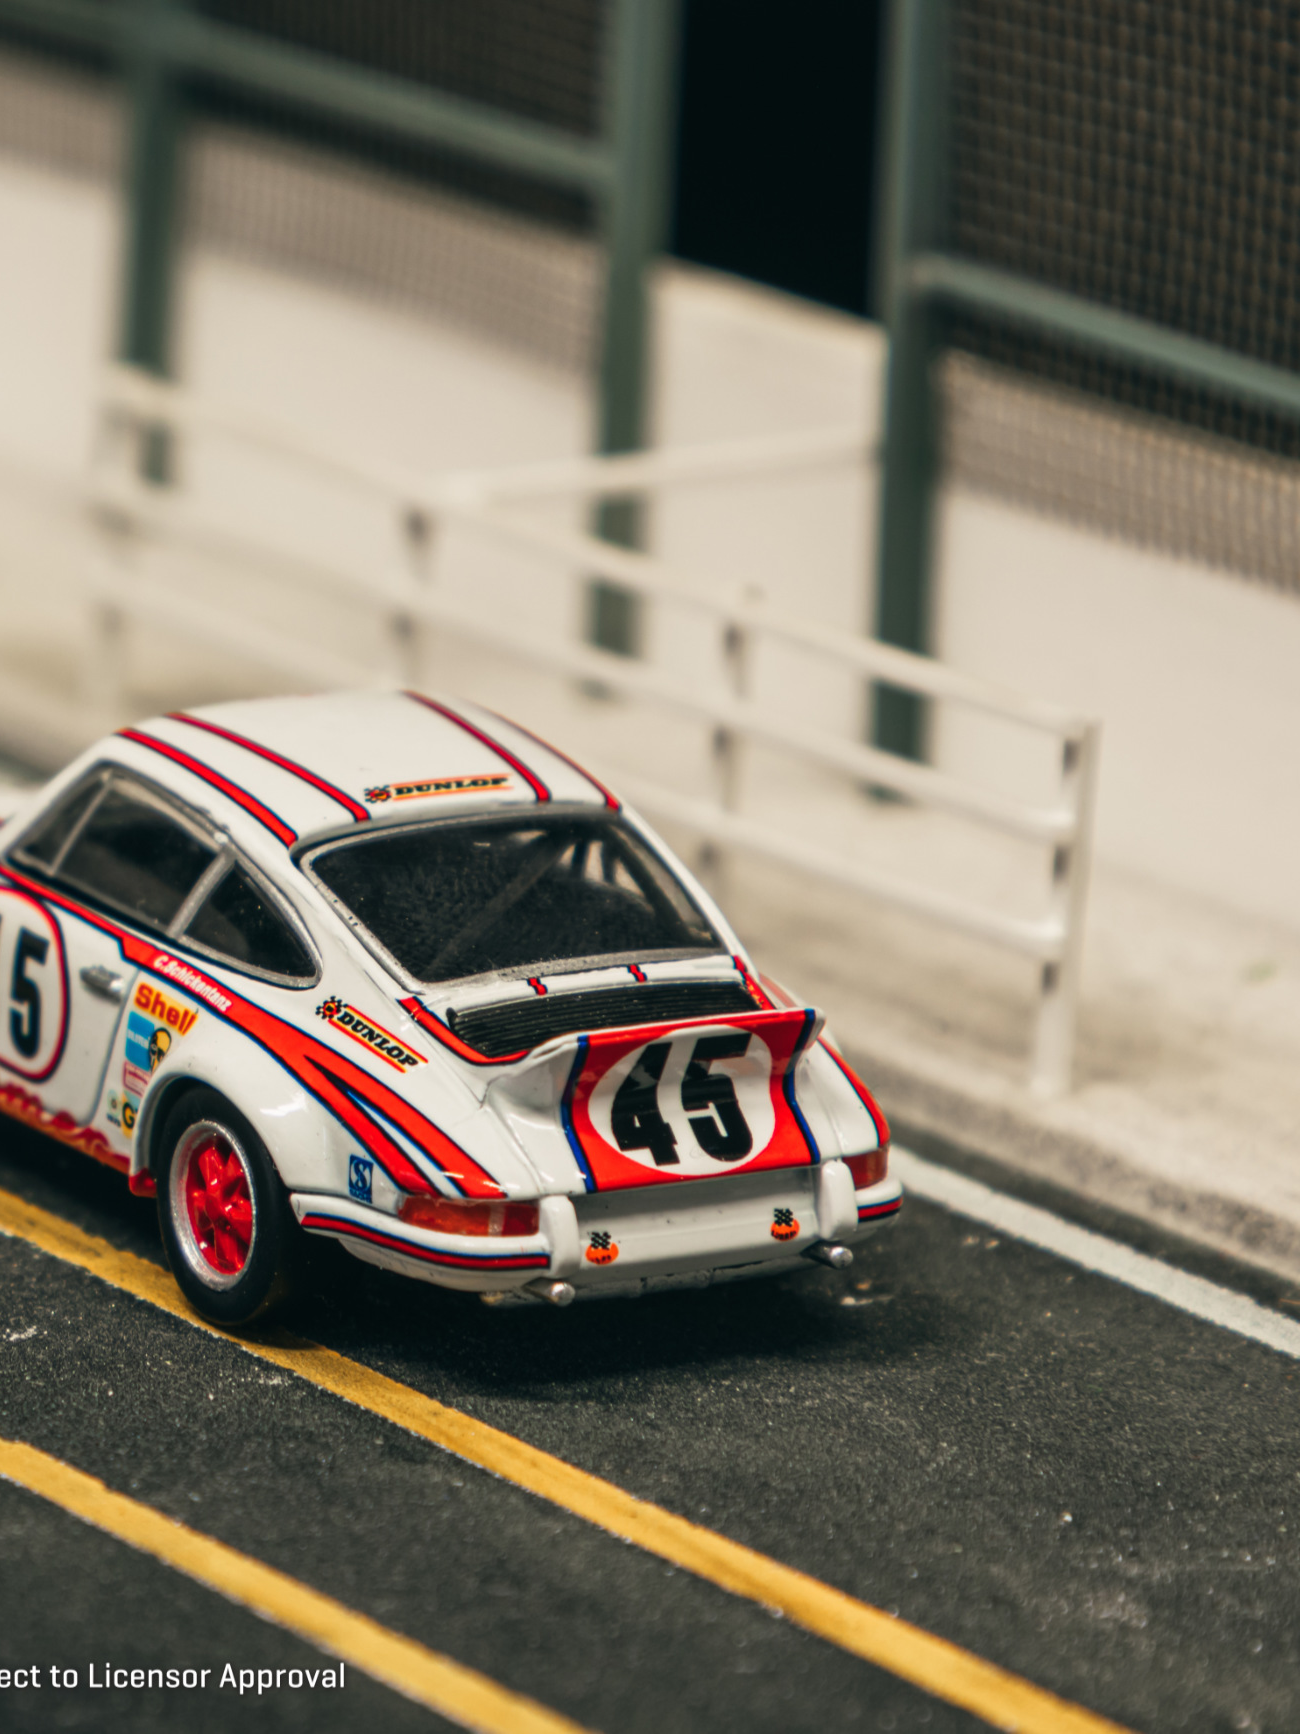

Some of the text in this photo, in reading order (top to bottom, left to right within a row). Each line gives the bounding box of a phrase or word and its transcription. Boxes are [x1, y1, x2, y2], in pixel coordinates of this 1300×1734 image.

[394, 777, 508, 796] DUNLOP
[135, 983, 198, 1034] Shell
[336, 1010, 419, 1068] DUNLOP
[611, 1031, 754, 1167] 45
